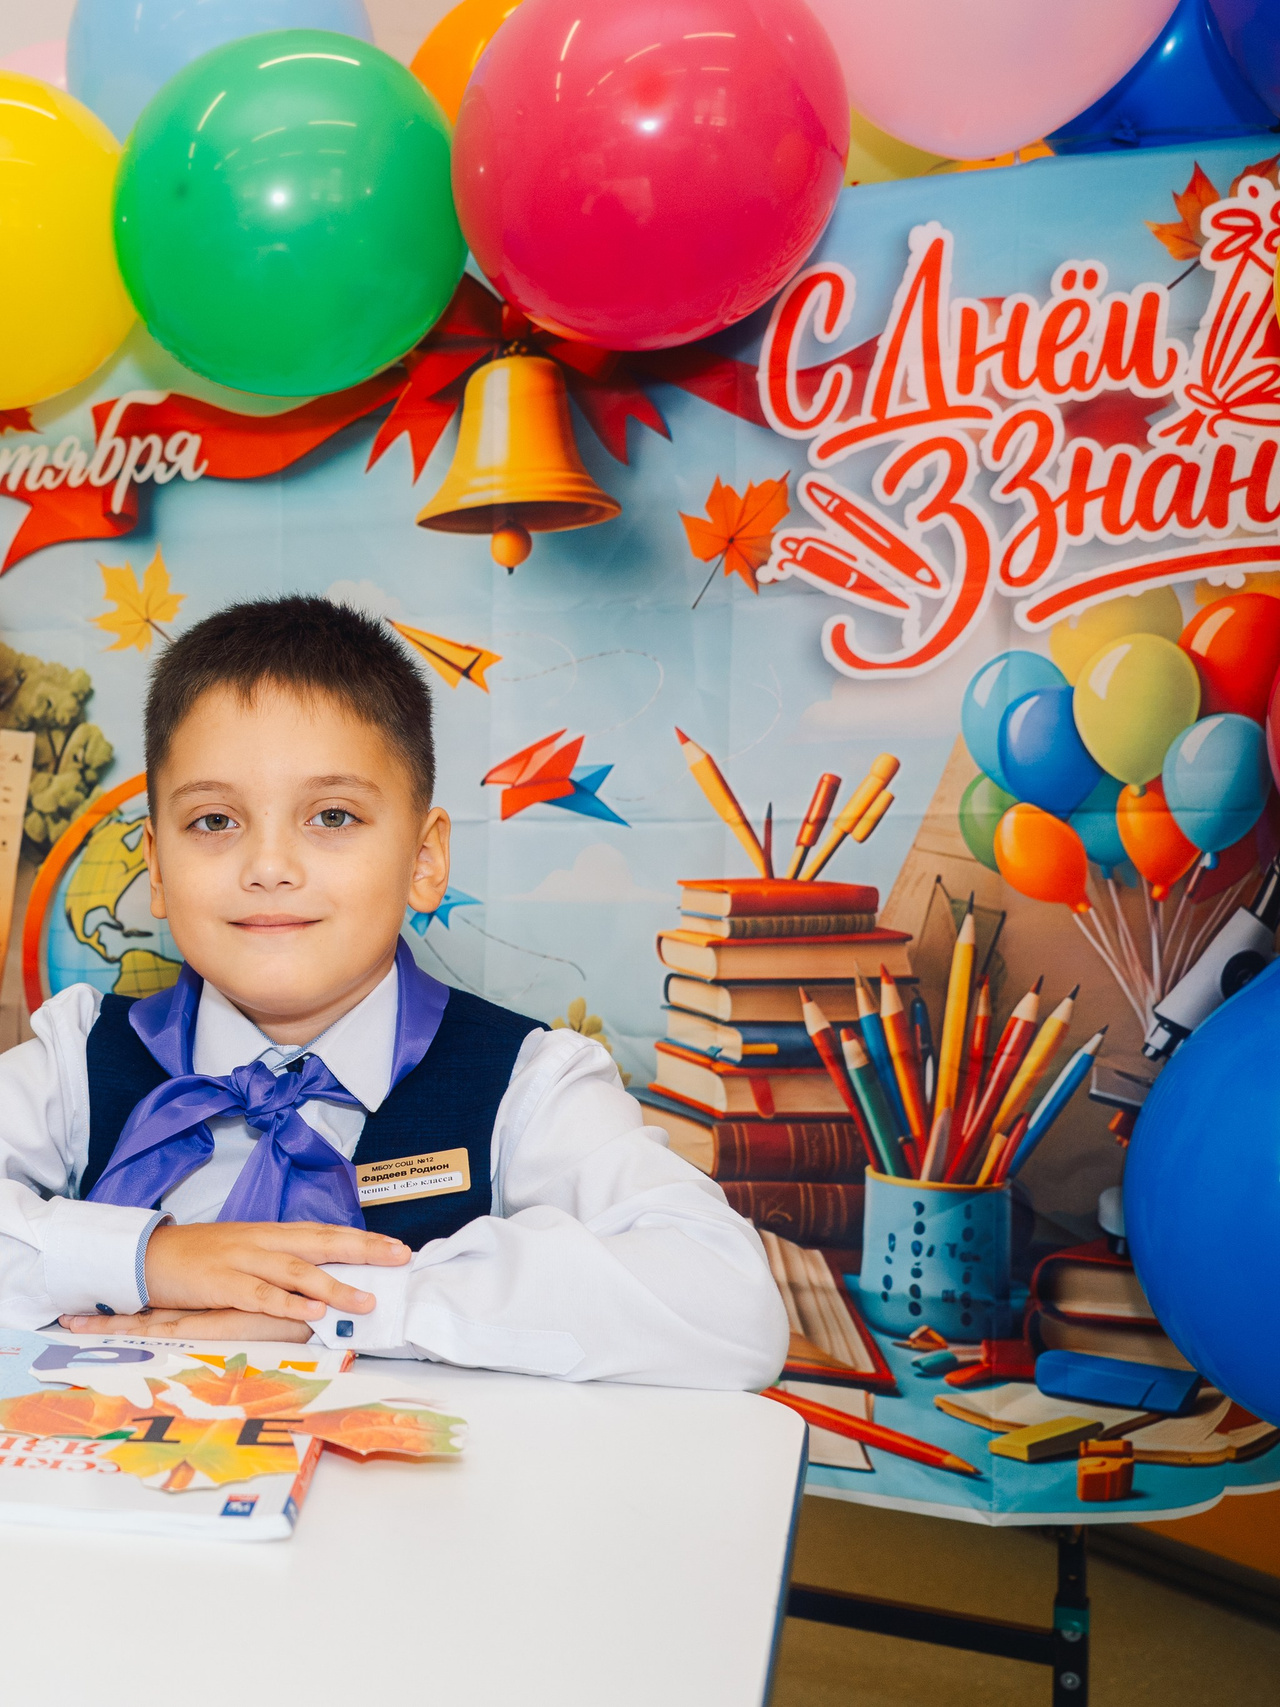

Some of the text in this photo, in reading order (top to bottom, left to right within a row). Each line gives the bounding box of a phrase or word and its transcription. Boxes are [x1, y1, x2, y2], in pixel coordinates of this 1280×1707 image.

[763, 265, 851, 435] С
[361, 1163, 449, 1182] Фардеев Родион
[371, 1156, 434, 1173] МБОУ СОШ №12
[358, 1185, 391, 1196] ченик
[420, 1175, 453, 1186] класса
[125, 1415, 181, 1444] 1
